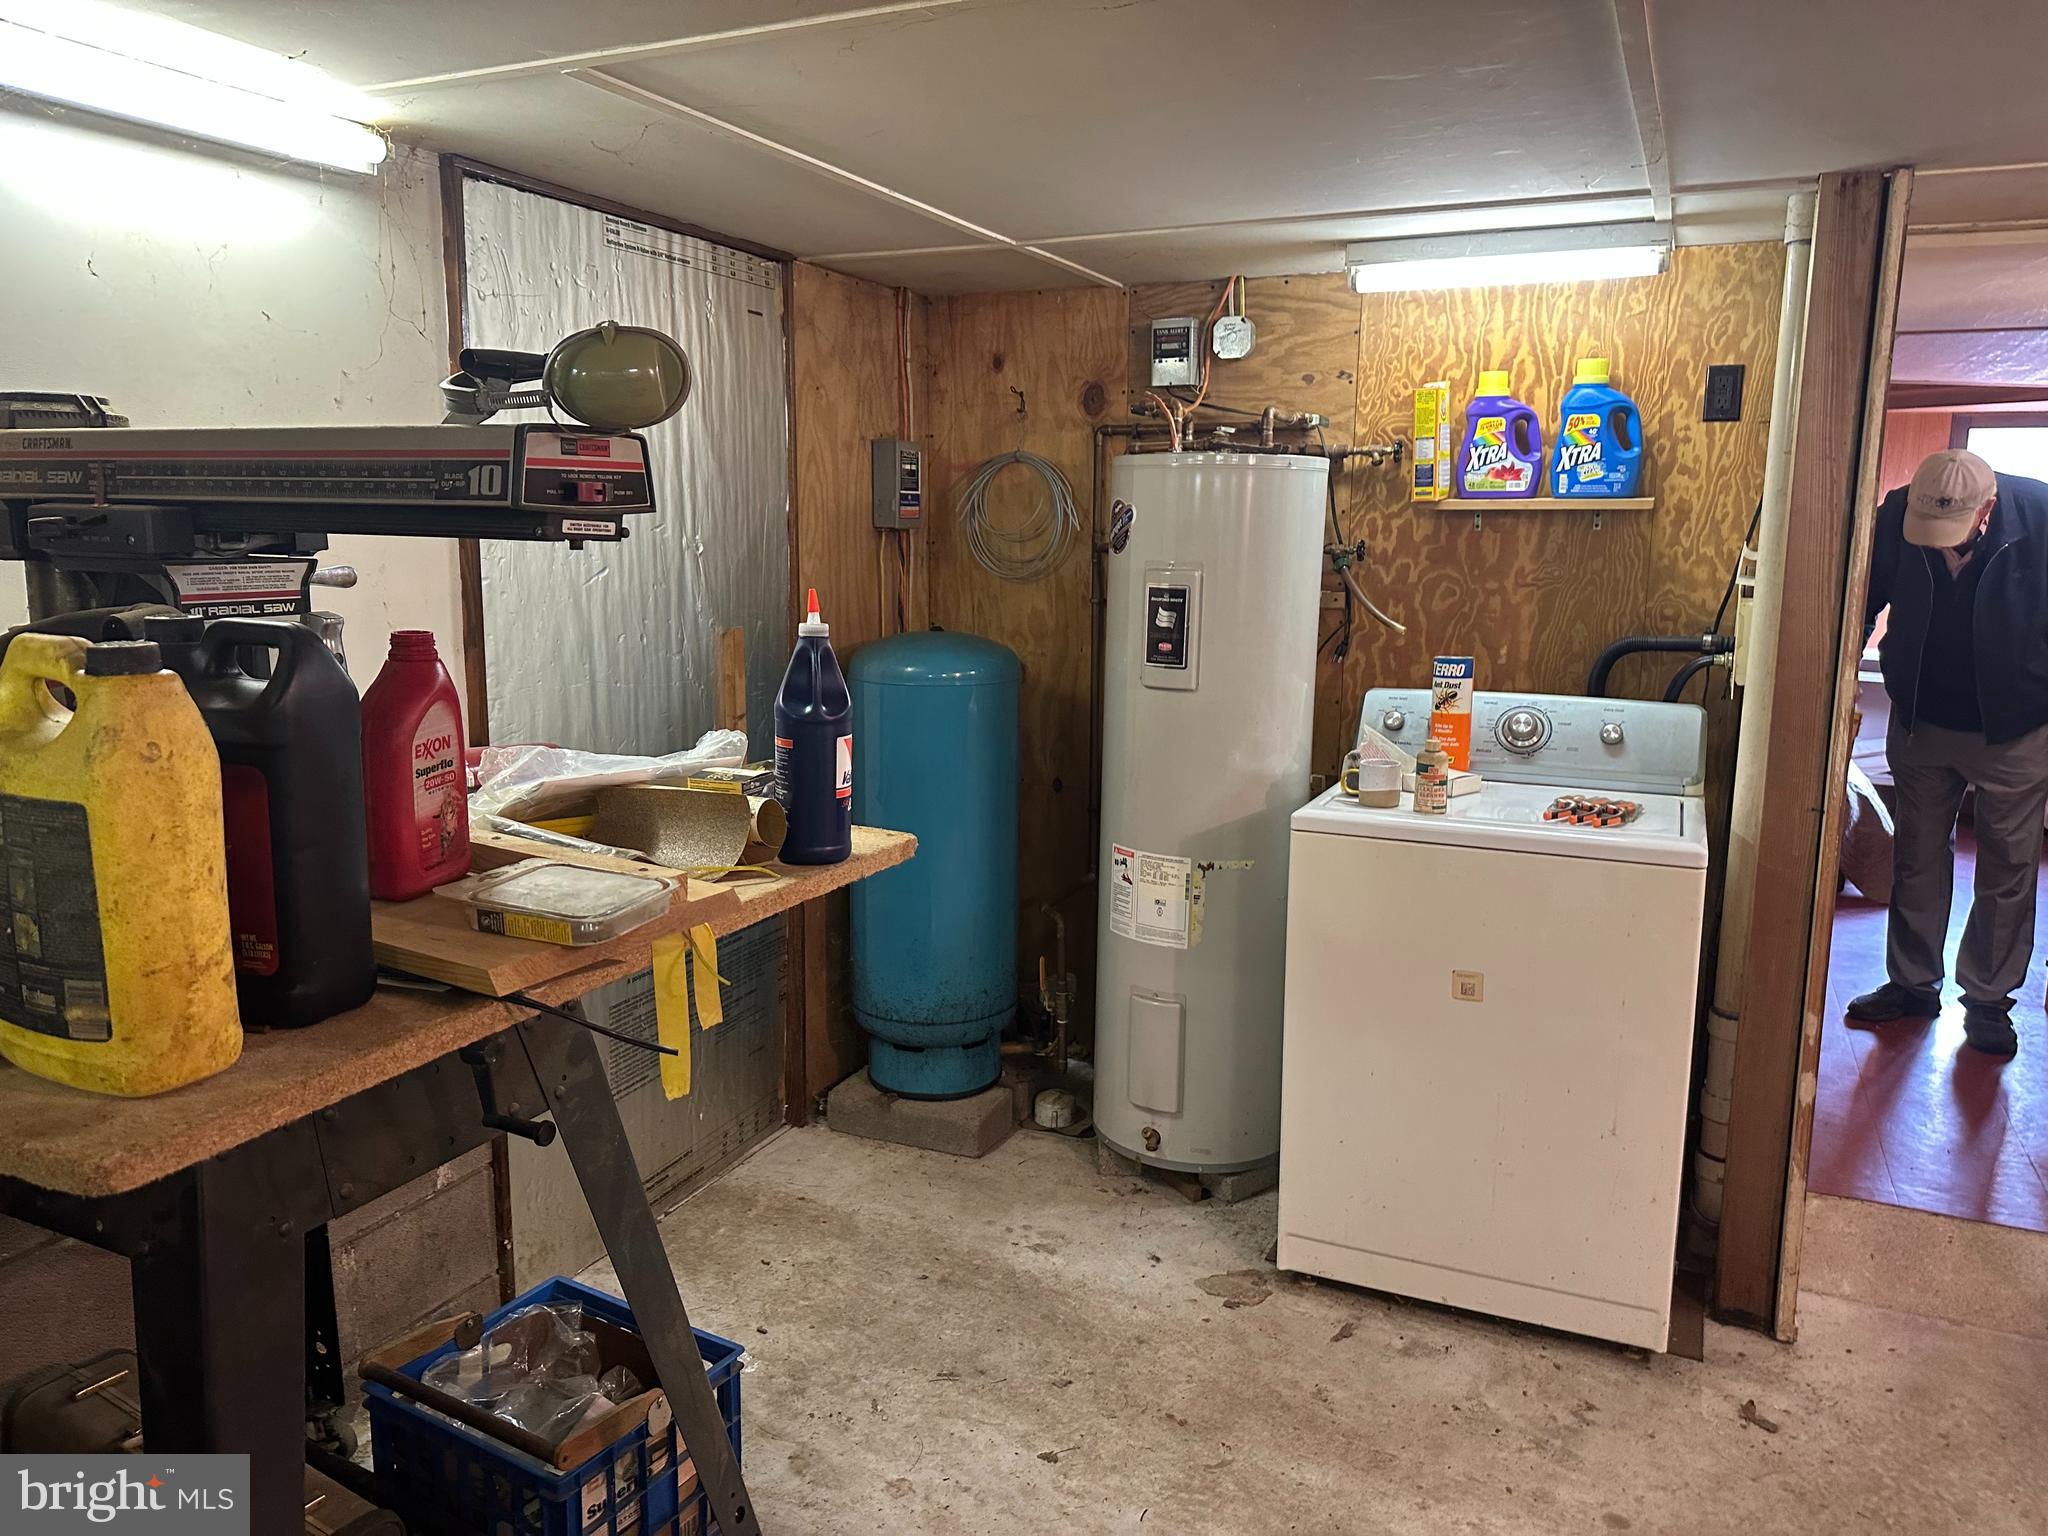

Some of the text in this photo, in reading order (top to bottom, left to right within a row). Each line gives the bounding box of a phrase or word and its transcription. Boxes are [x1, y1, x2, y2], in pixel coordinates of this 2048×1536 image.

[22, 437, 73, 450] CRAFTSMAN
[1466, 442, 1507, 472] XTRA
[1556, 442, 1601, 472] XTRA
[46, 470, 83, 484] SAW
[468, 464, 502, 496] 10
[208, 605, 260, 616] RADIAL
[263, 603, 295, 613] SAW
[1433, 662, 1465, 677] TERRO
[1444, 681, 1462, 689] Dust
[415, 735, 451, 760] EXXON
[416, 759, 453, 778] Superflo
[425, 772, 455, 788] 20W-50
